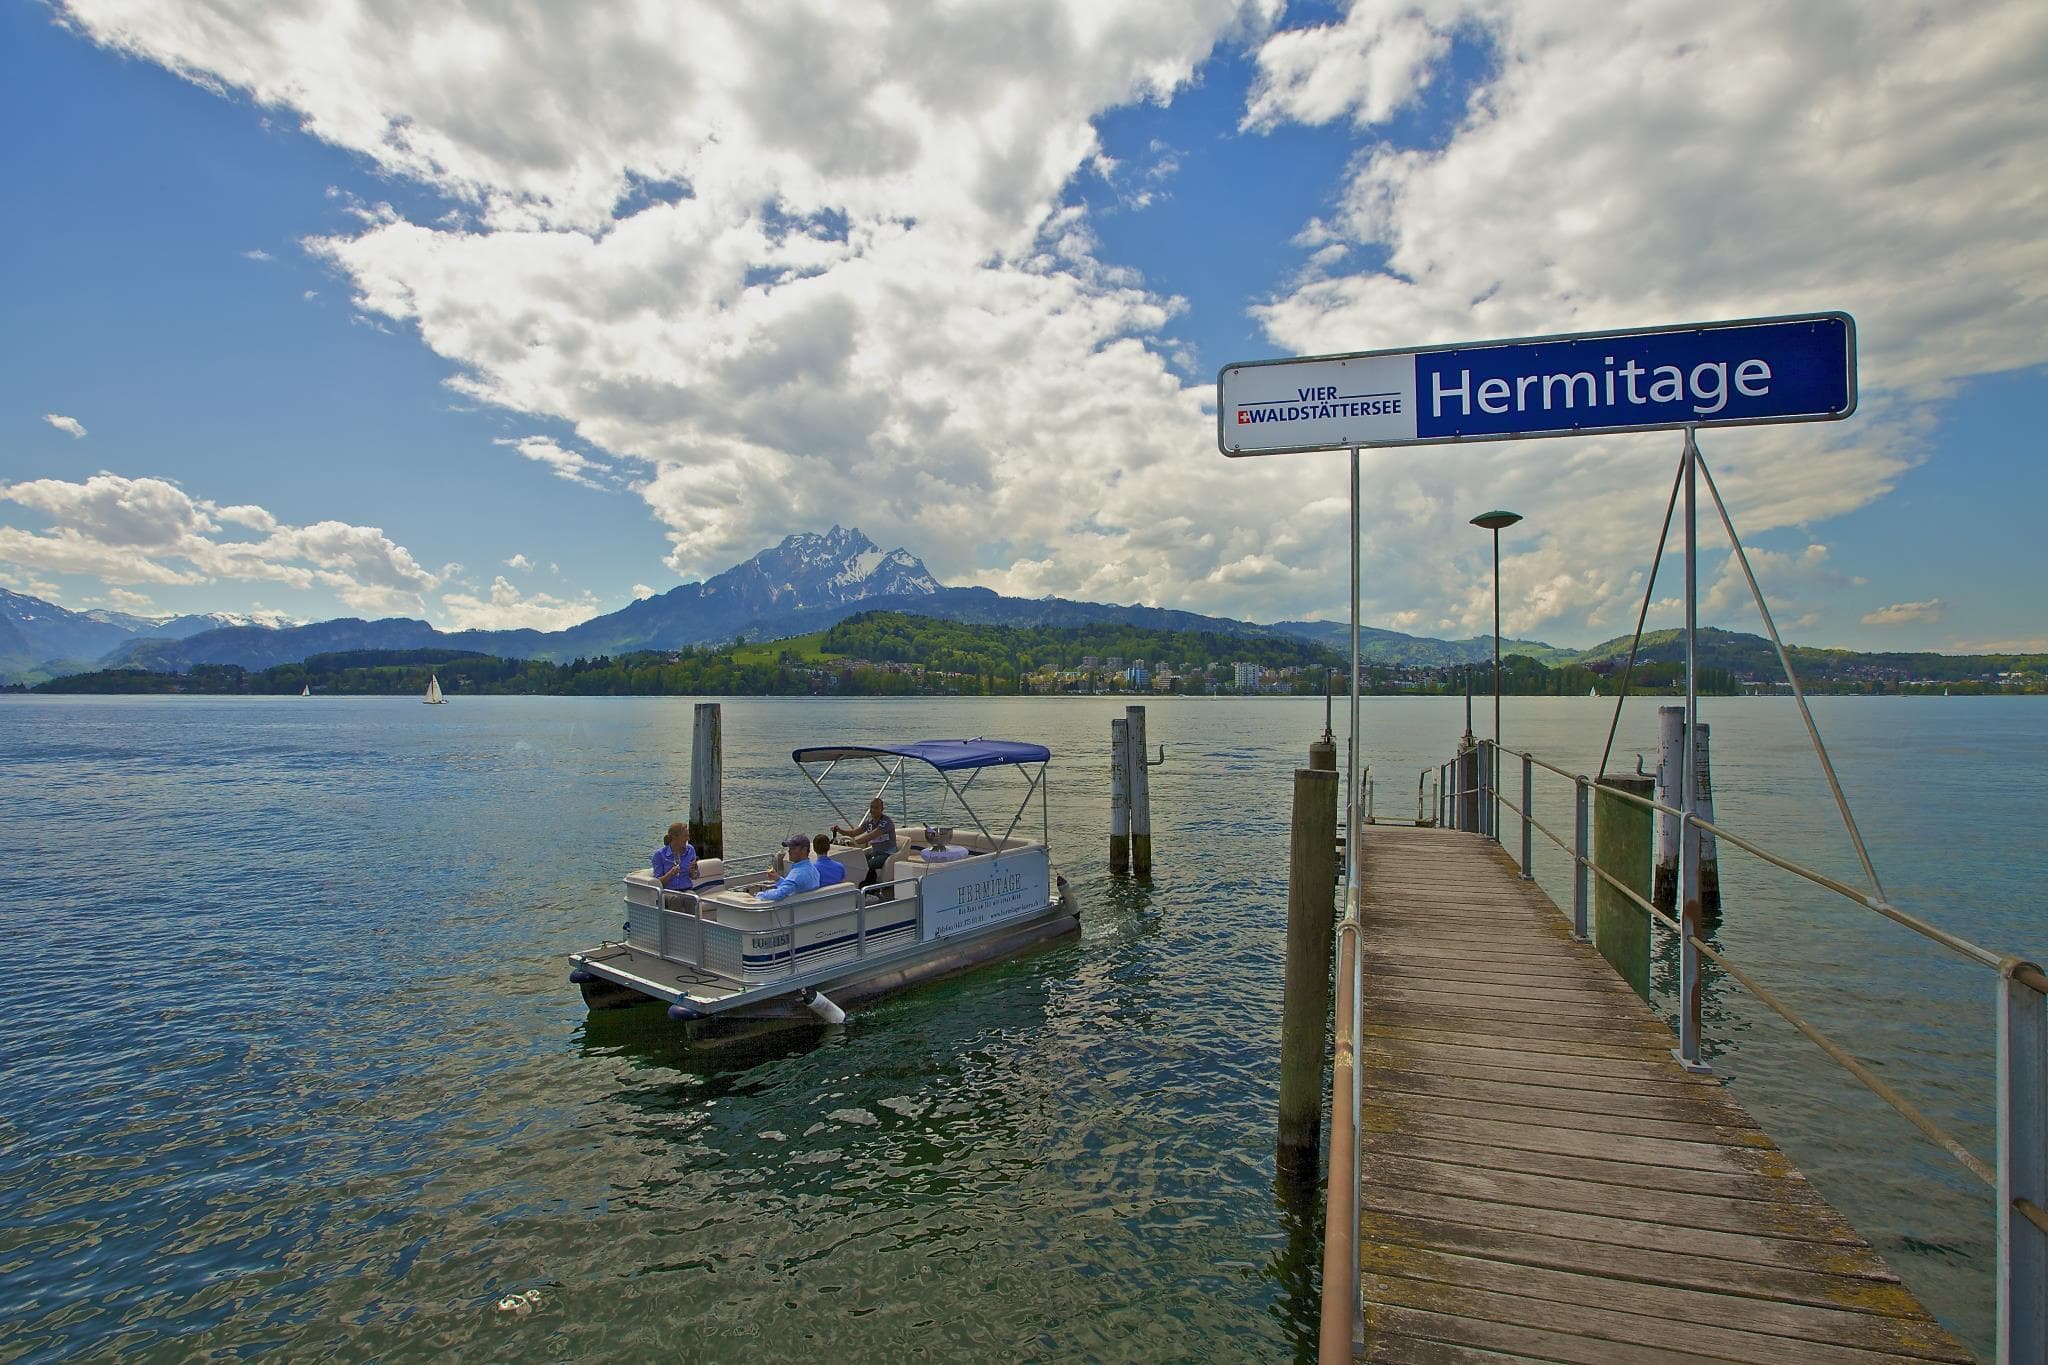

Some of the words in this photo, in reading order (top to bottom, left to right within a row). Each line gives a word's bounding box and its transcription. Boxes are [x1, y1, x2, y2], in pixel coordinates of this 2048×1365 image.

[1298, 386, 1339, 403] VIER
[1431, 356, 1773, 419] Hermitage
[1249, 400, 1402, 424] WALDSTÄTTERSEE
[957, 873, 1022, 905] HERMITAGE
